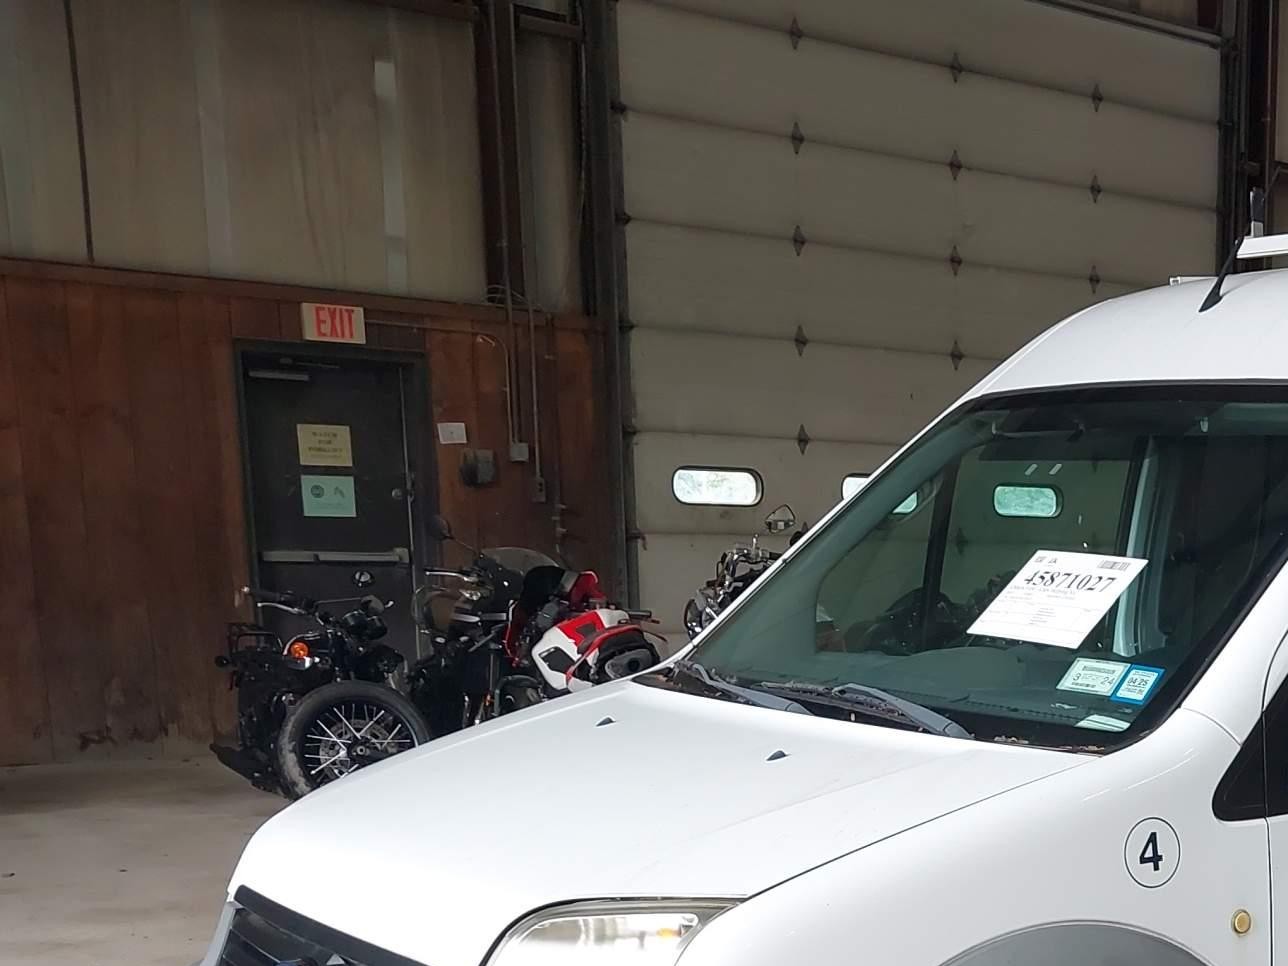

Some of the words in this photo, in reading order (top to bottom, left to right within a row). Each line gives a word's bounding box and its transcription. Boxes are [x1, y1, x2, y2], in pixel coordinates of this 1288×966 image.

[315, 306, 356, 339] EXIT
[1023, 570, 1117, 593] 45871027
[1139, 831, 1163, 872] 4
